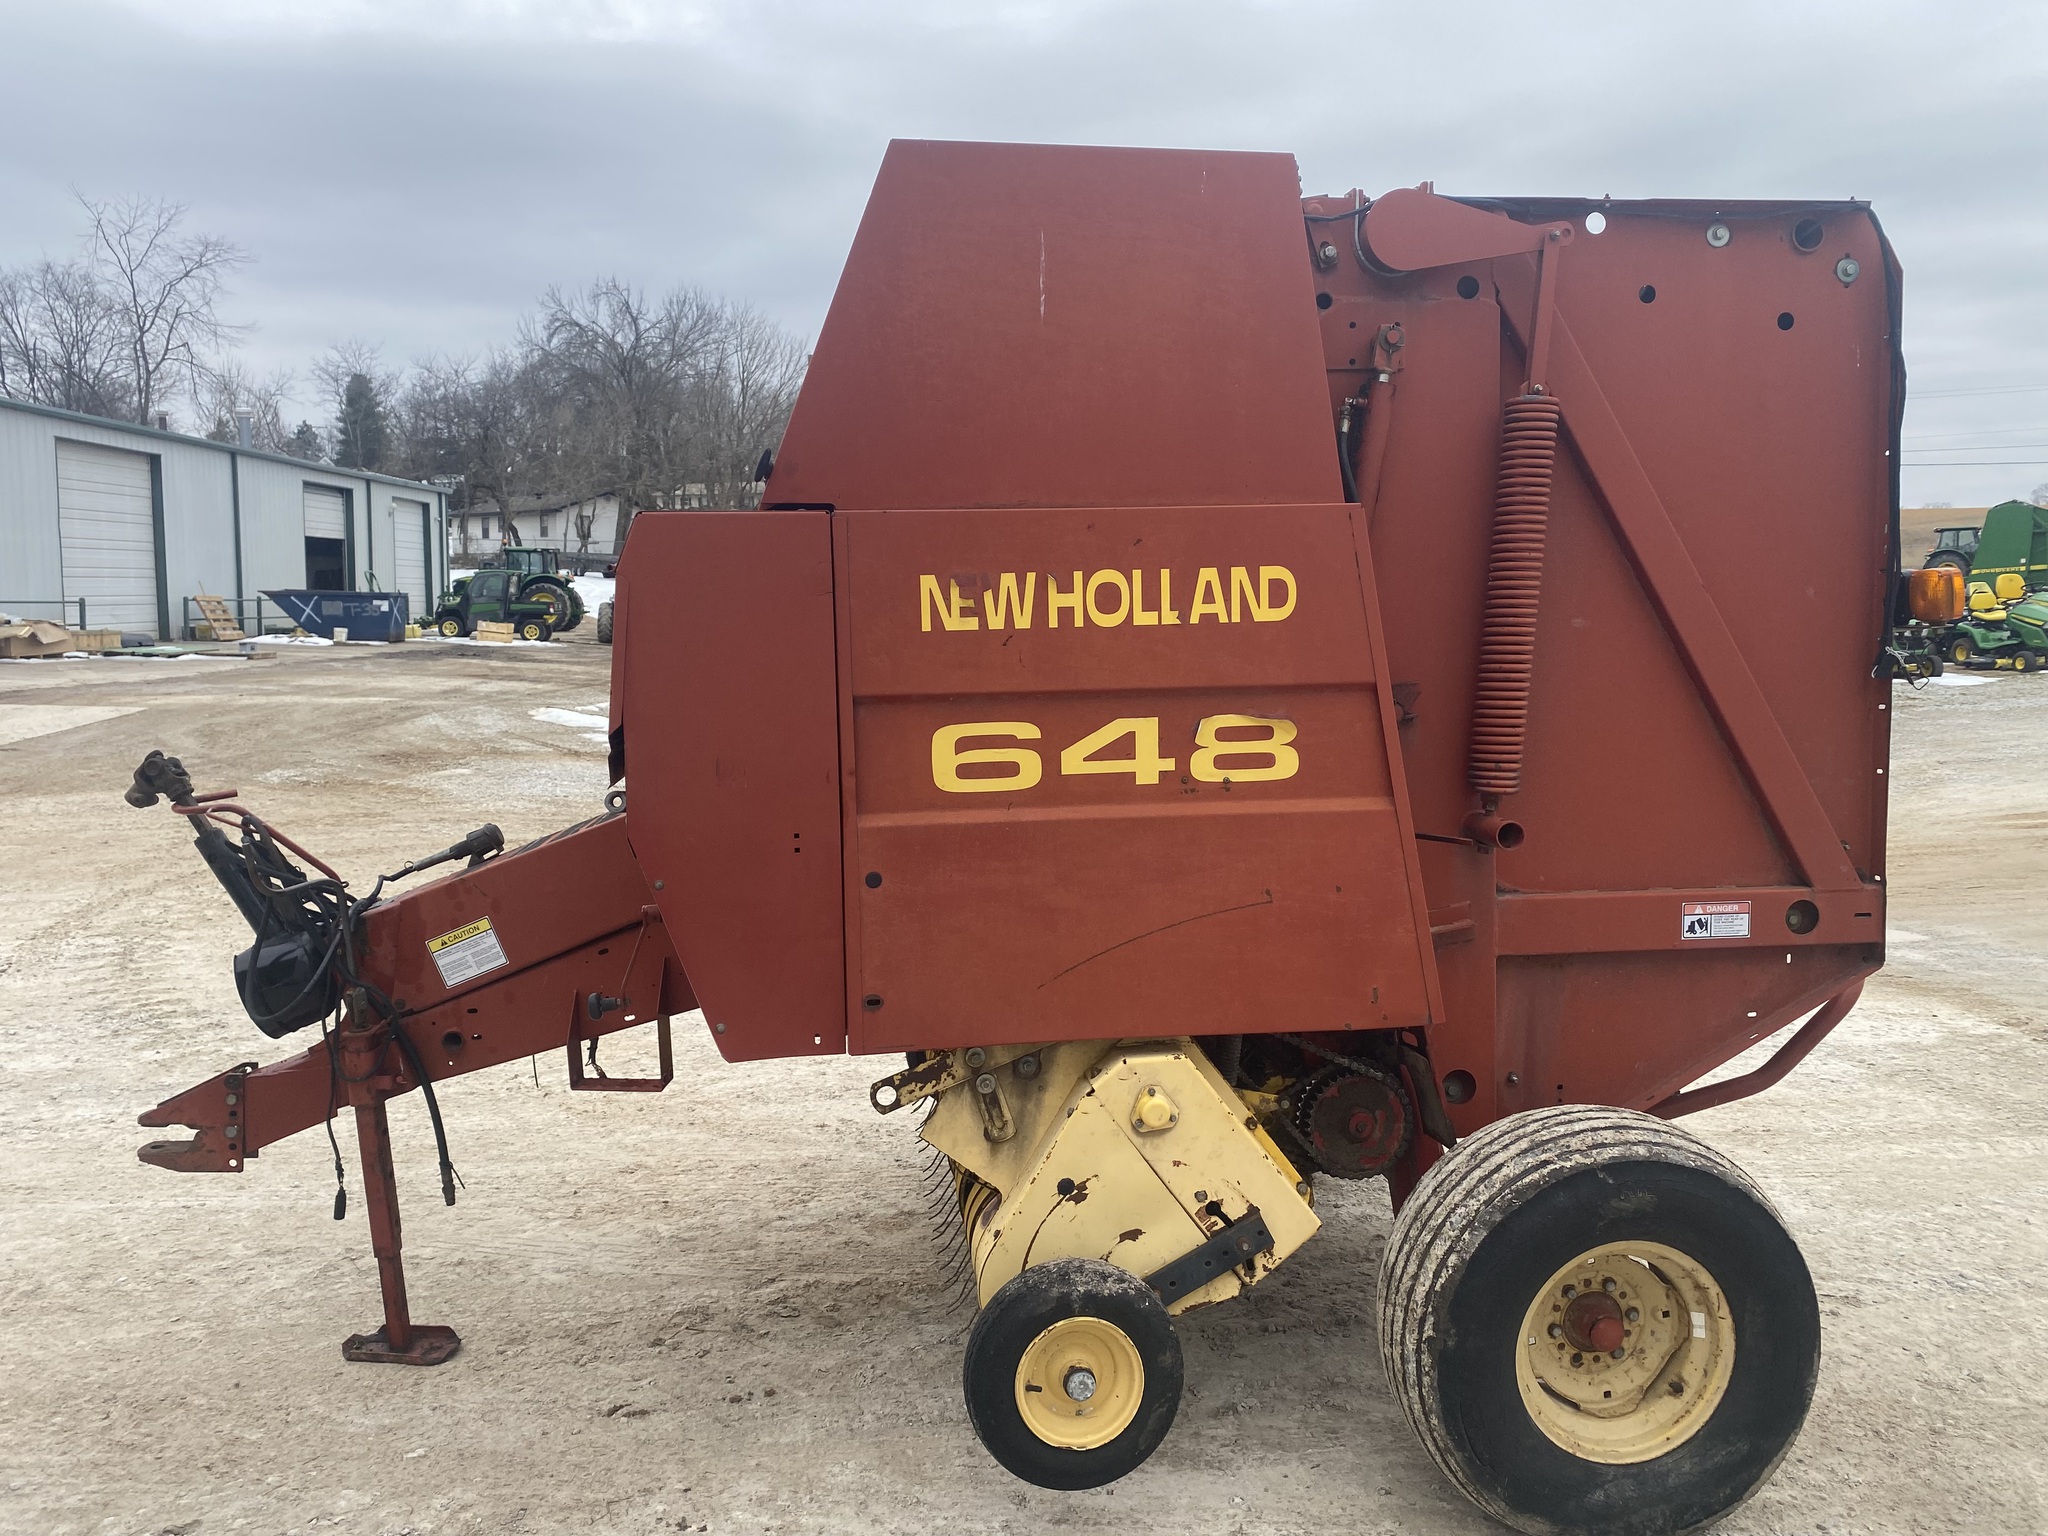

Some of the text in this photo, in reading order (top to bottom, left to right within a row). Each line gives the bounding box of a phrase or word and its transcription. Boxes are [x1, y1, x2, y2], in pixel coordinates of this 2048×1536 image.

[919, 565, 1298, 632] NEW HOLLAND
[931, 714, 1300, 793] 648
[1706, 904, 1739, 913] DANGER
[447, 924, 480, 943] CAUTION
